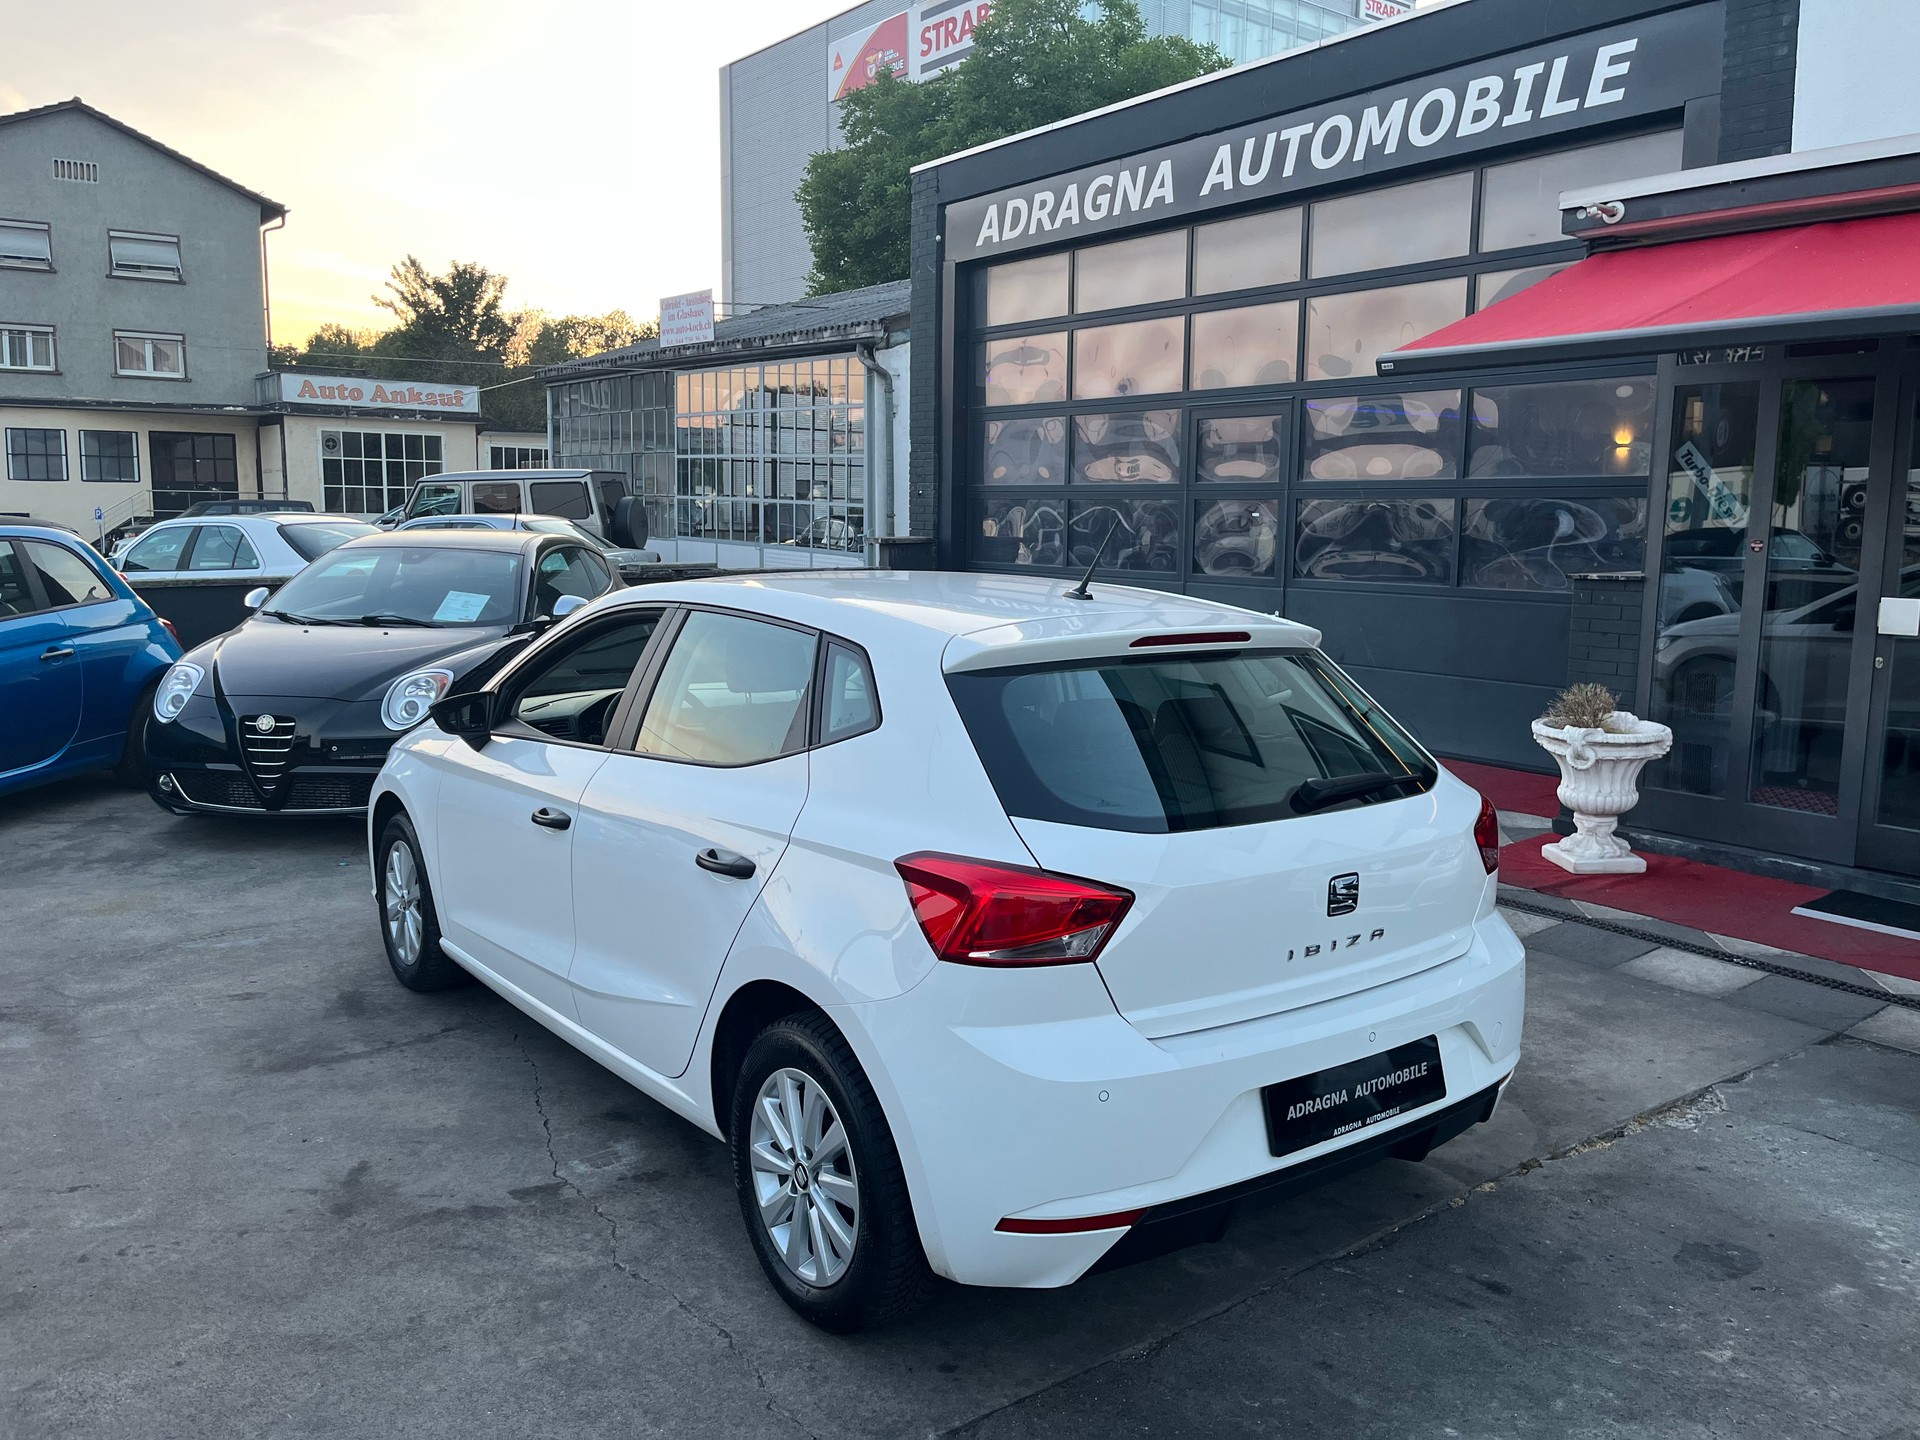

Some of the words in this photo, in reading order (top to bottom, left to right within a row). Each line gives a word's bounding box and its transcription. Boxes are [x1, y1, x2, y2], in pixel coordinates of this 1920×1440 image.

[1366, 0, 1407, 17] STRABA
[920, 3, 990, 57] STRAB
[974, 158, 1174, 247] ADRAGNA
[1199, 37, 1638, 196] AUTOMOBILE
[668, 312, 675, 321] im
[677, 308, 705, 320] Glashaus
[298, 379, 364, 401] Auto
[370, 384, 464, 407] Ankauf
[1287, 927, 1384, 962] IBIZA
[1286, 1089, 1348, 1121] ADRAGNA
[1354, 1062, 1428, 1099] AUTOMOBILE
[1333, 1120, 1362, 1136] ADRAGNA
[1366, 1106, 1400, 1125] AUTOMOBILE
